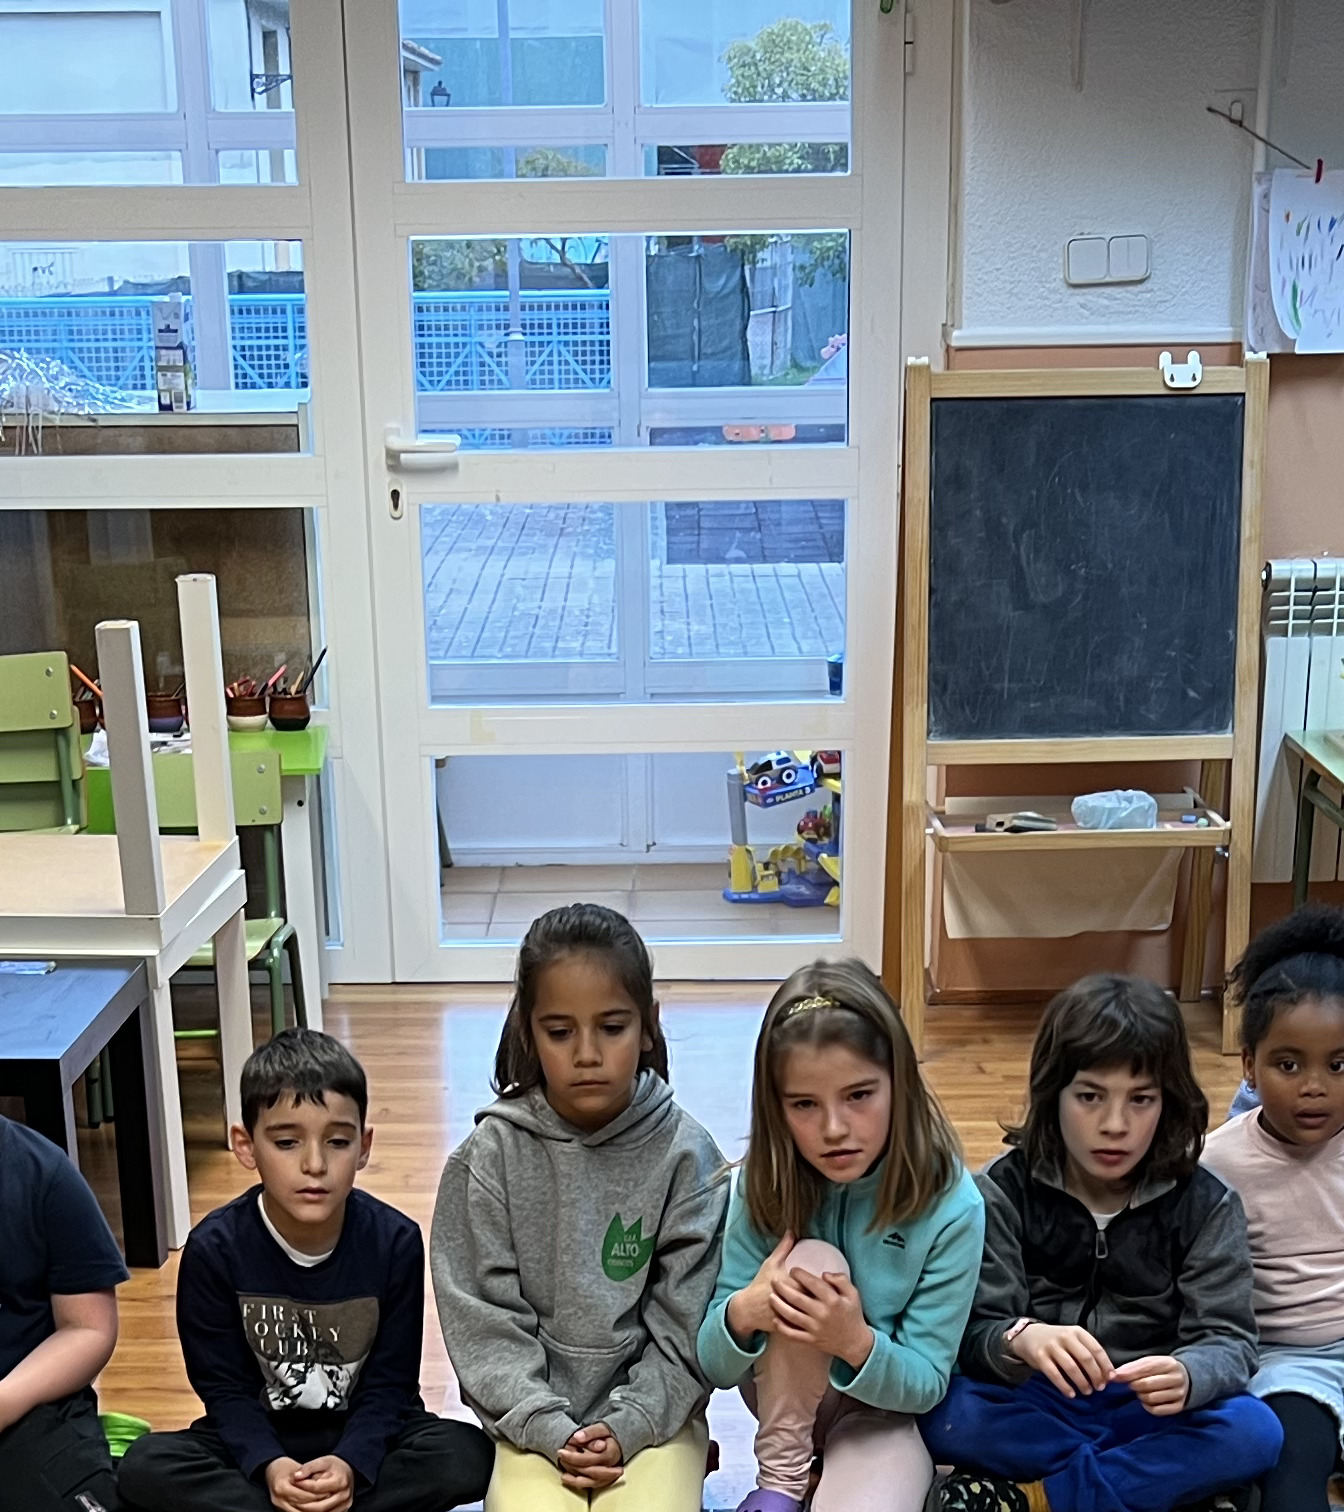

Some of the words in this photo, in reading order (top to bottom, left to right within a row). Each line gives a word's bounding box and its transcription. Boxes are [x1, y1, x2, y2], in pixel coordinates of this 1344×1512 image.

[610, 1242, 640, 1258] ALTO
[242, 1302, 317, 1325] FIRST
[253, 1321, 342, 1343] OCKEY
[259, 1339, 309, 1356] LUB
